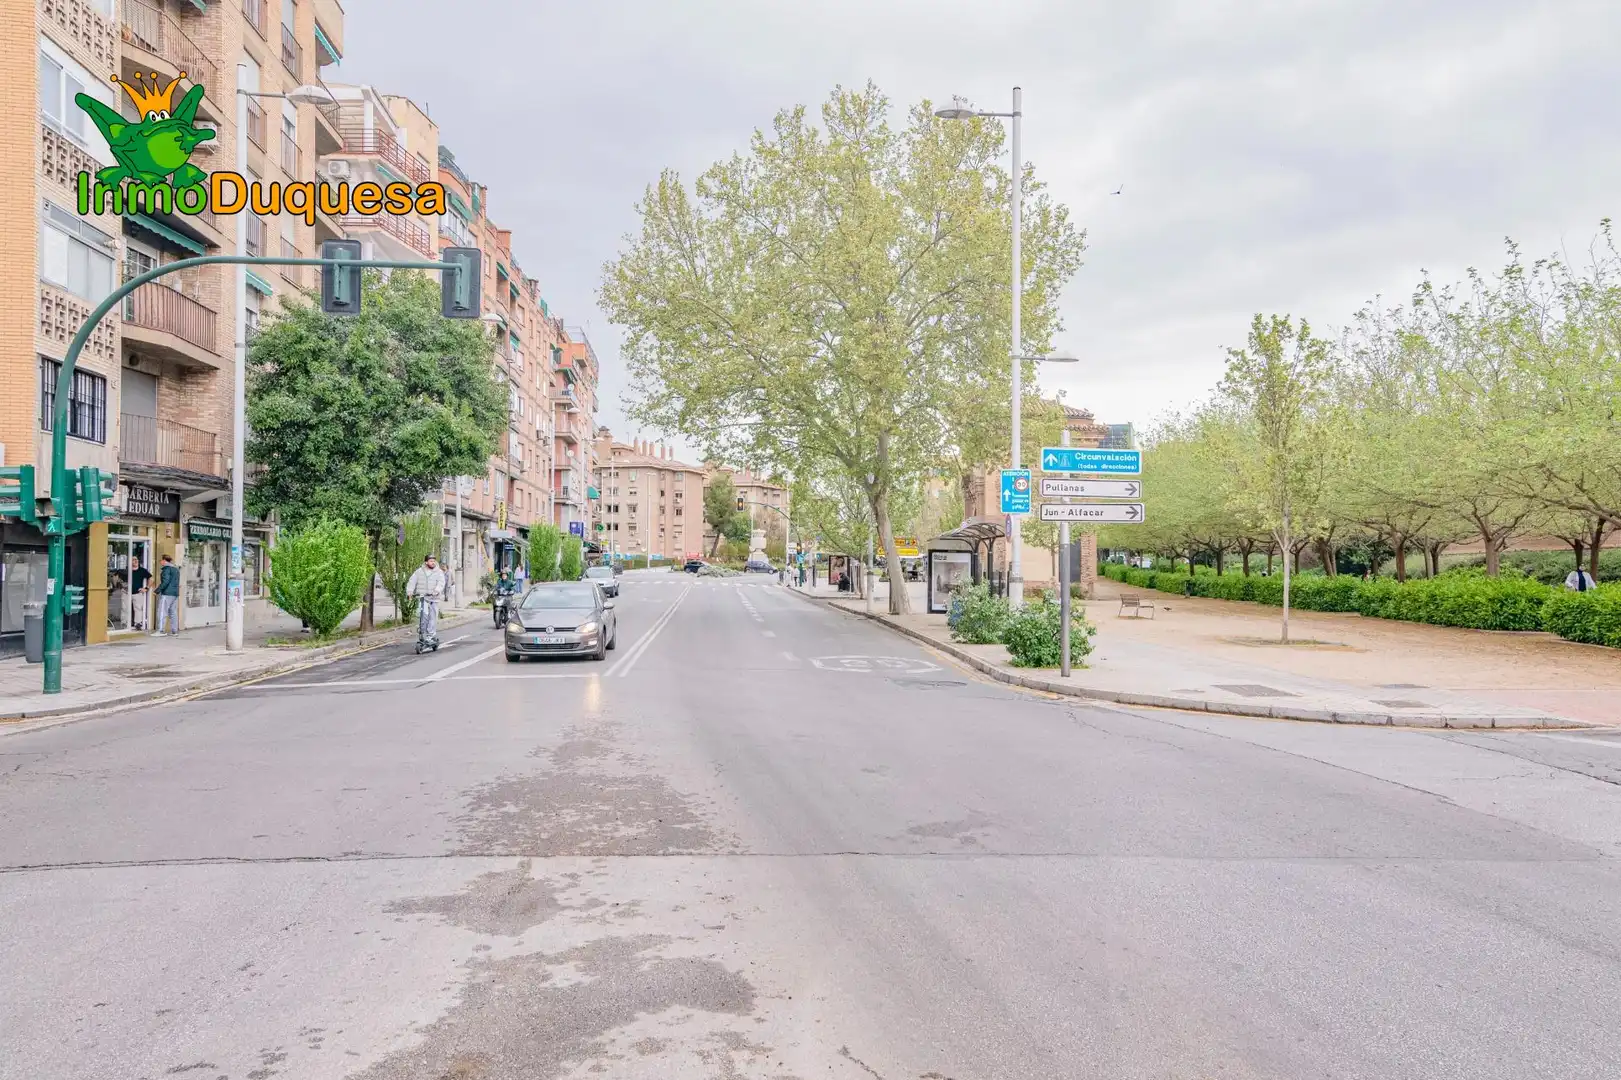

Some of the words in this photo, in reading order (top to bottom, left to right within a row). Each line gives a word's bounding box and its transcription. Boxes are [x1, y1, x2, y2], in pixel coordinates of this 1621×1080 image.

[1074, 452, 1137, 462] Circunvalación
[1045, 483, 1085, 492] Pulianas
[129, 501, 161, 516] EDUAR
[1044, 508, 1059, 516] Jun
[1067, 508, 1104, 516] Alfacar
